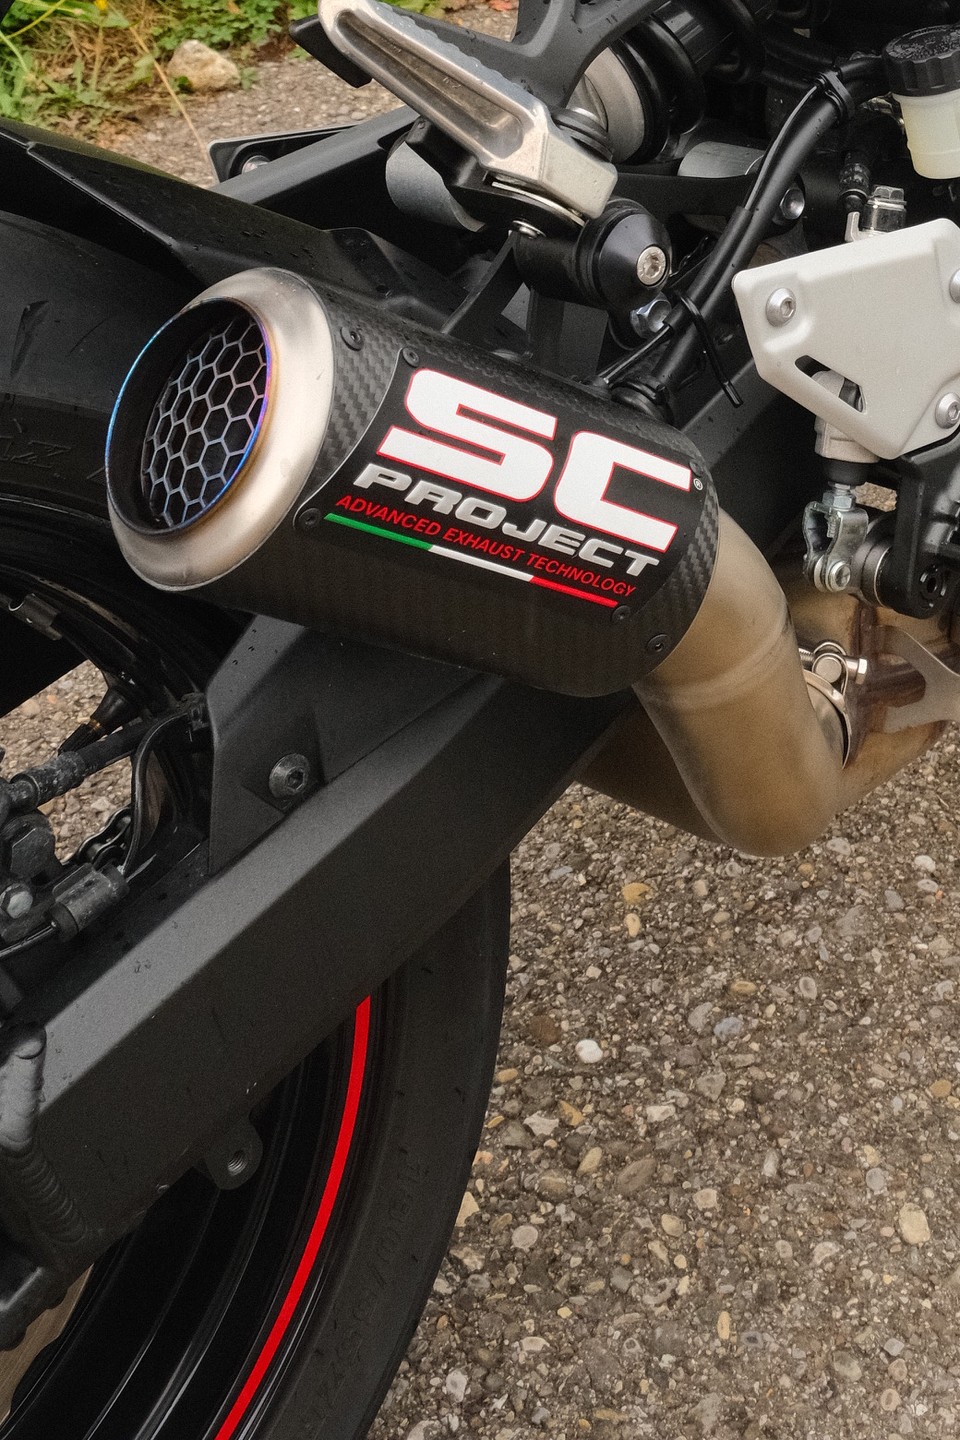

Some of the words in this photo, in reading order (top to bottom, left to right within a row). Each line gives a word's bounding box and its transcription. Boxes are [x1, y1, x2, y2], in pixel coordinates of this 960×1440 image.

[376, 367, 693, 554] SC
[335, 494, 442, 536] ADVANCED
[442, 526, 526, 562] EXHAUST
[526, 552, 637, 597] TECHNOLOGY
[353, 462, 660, 578] PROJECT
